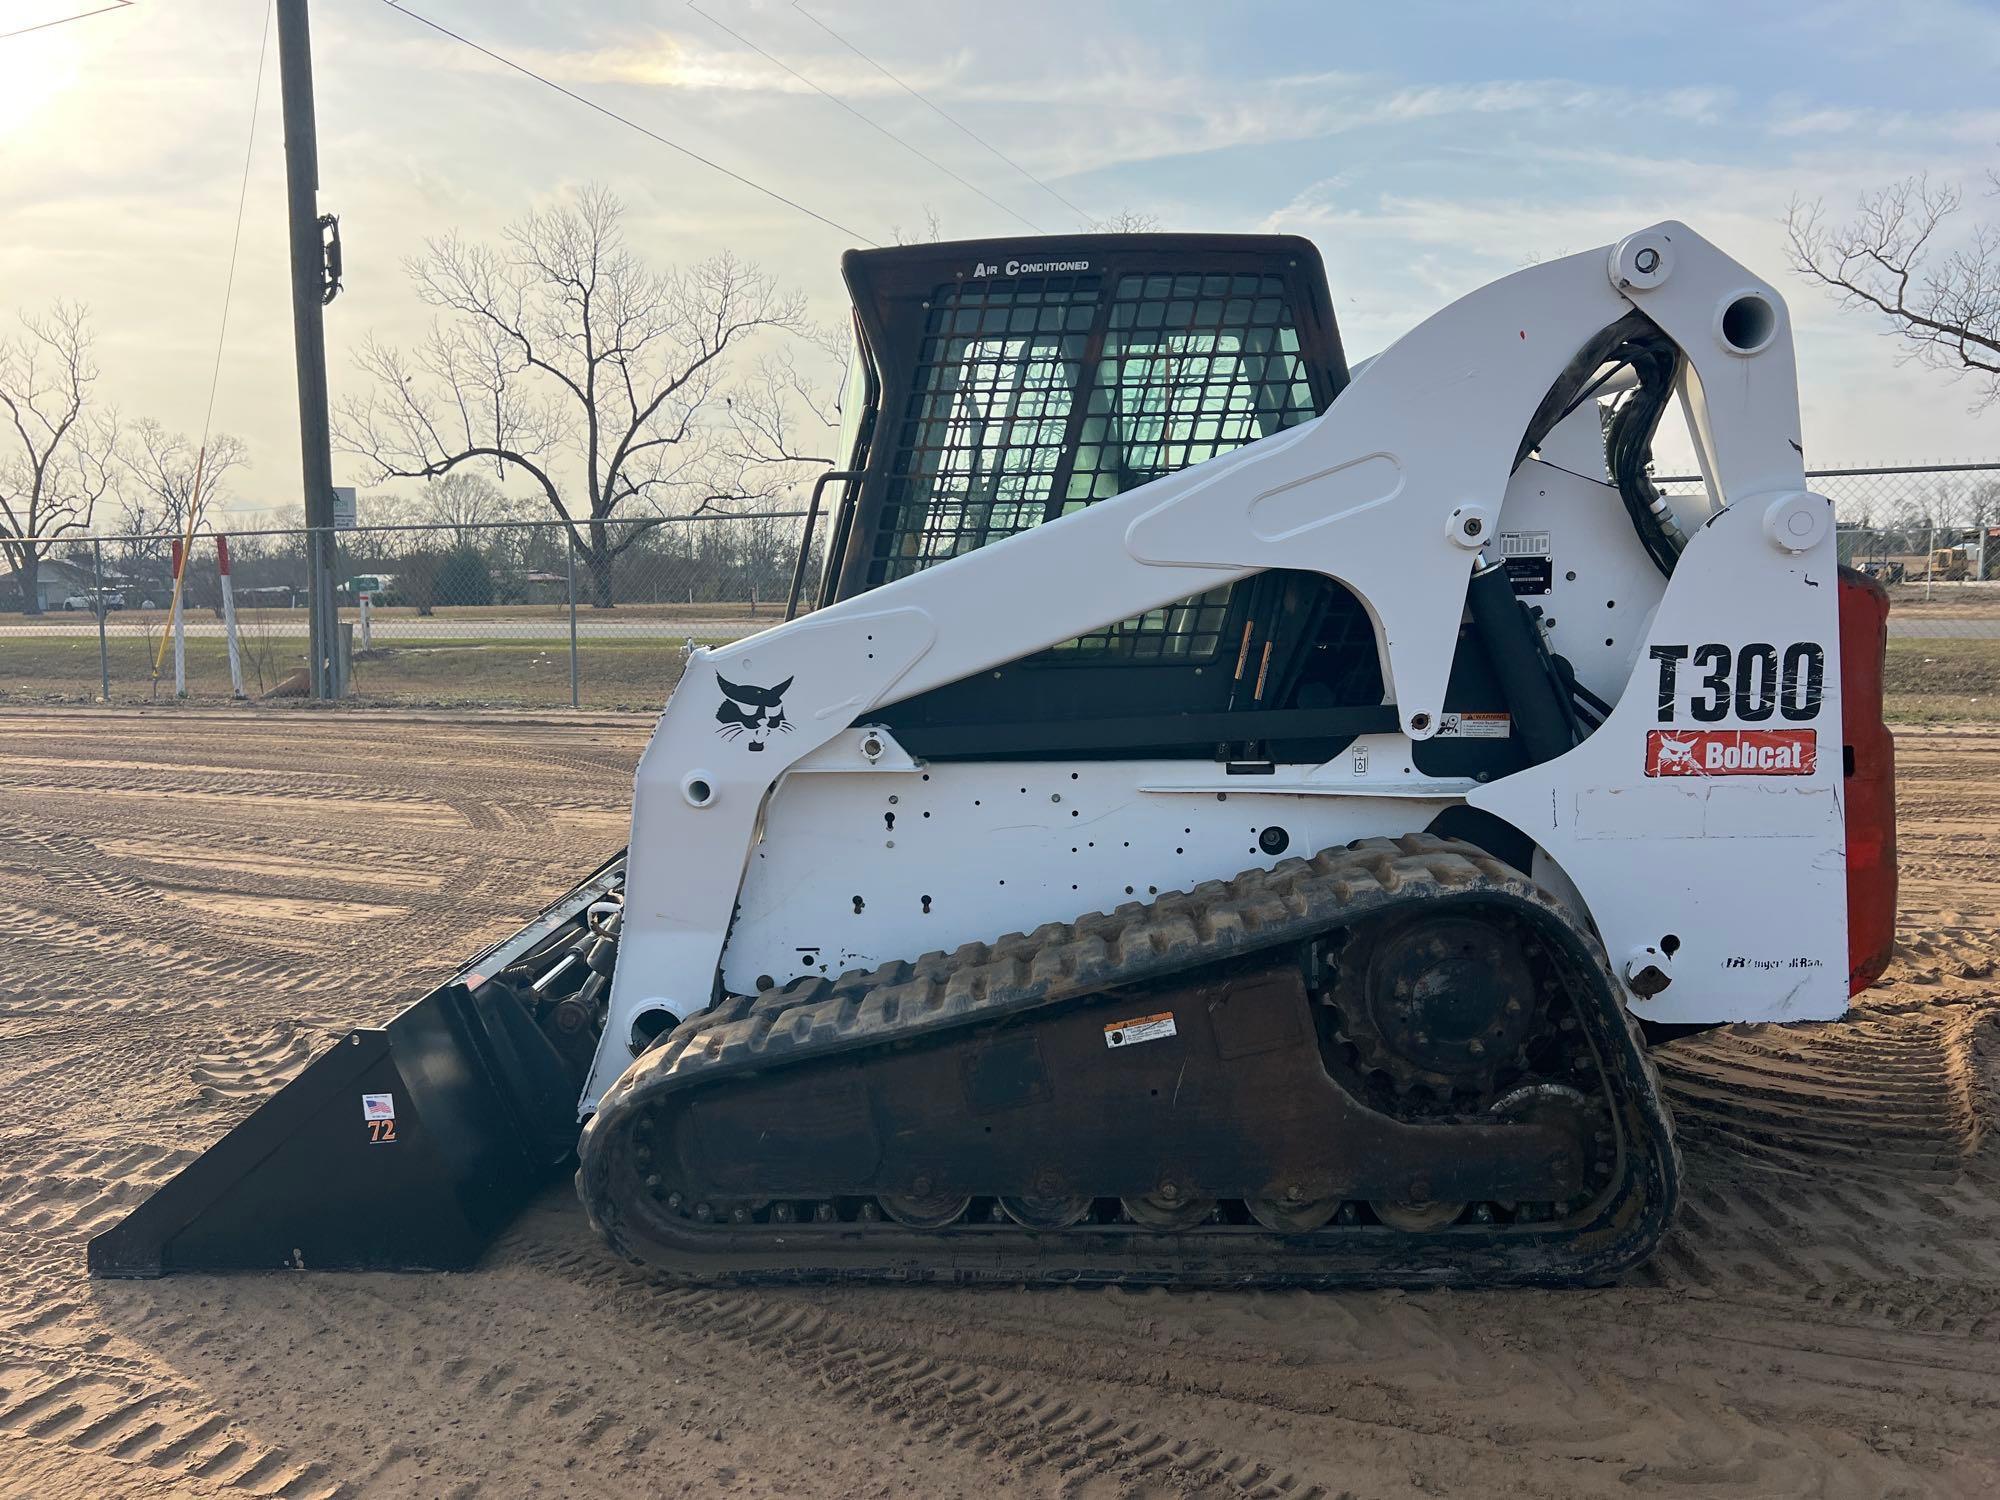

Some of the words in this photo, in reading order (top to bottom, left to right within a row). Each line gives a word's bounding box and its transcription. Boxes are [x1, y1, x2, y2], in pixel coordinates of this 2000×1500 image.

[1649, 641, 1825, 723] T300
[1705, 741, 1802, 769] Bobcat
[368, 1120, 396, 1141] 72
